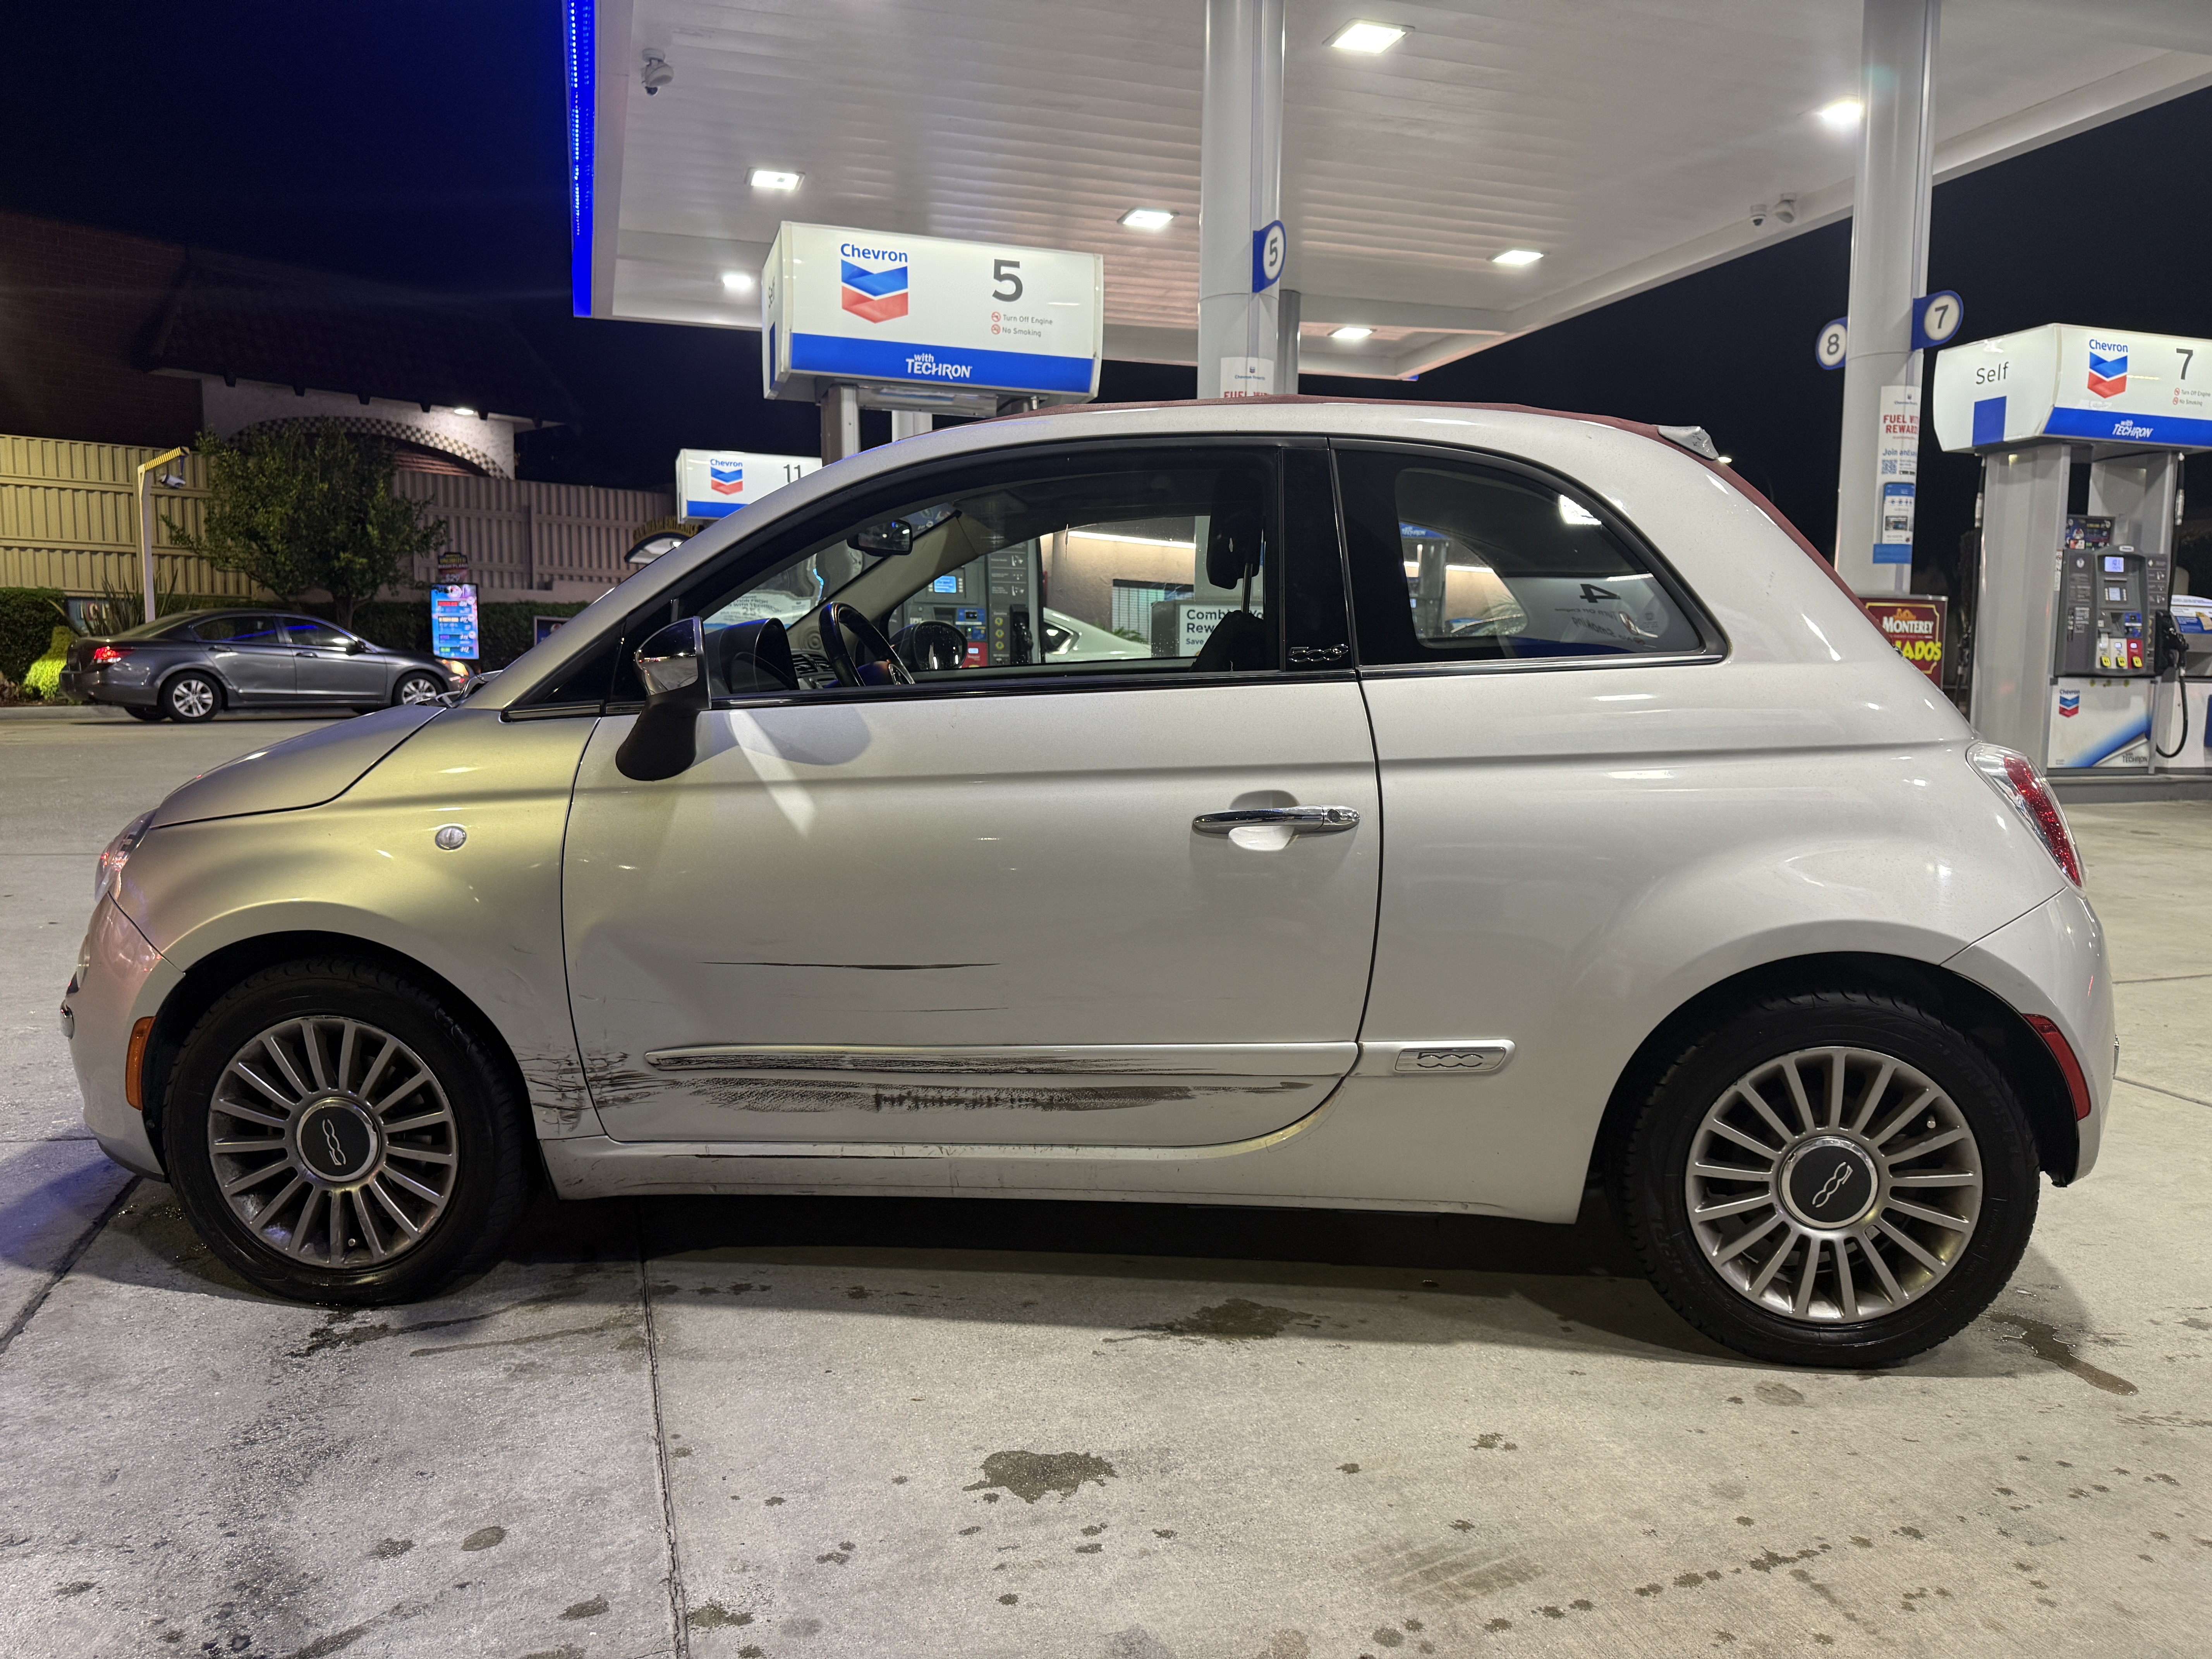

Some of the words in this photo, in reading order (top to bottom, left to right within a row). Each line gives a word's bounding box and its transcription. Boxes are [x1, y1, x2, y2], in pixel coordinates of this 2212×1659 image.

[841, 243, 907, 263] Chevron
[1269, 237, 1278, 267] 5
[992, 259, 1023, 302] 5
[1031, 317, 1053, 325] Engine
[1935, 304, 1949, 329] 7
[1013, 328, 1042, 338] Smoking
[1827, 333, 1839, 356] 8
[2089, 339, 2128, 352] Chevron
[914, 353, 934, 362] with
[2176, 348, 2193, 380] 7
[905, 358, 971, 380] TECHRON
[1976, 361, 2009, 384] Self
[1883, 414, 1907, 424] FUEL
[2112, 423, 2154, 439] TECHRON
[1882, 448, 1898, 457] Join
[710, 459, 743, 467] Chevron
[783, 464, 802, 483] 11
[1882, 616, 1934, 634] MONTEREY
[1417, 1051, 1484, 1068] 500
